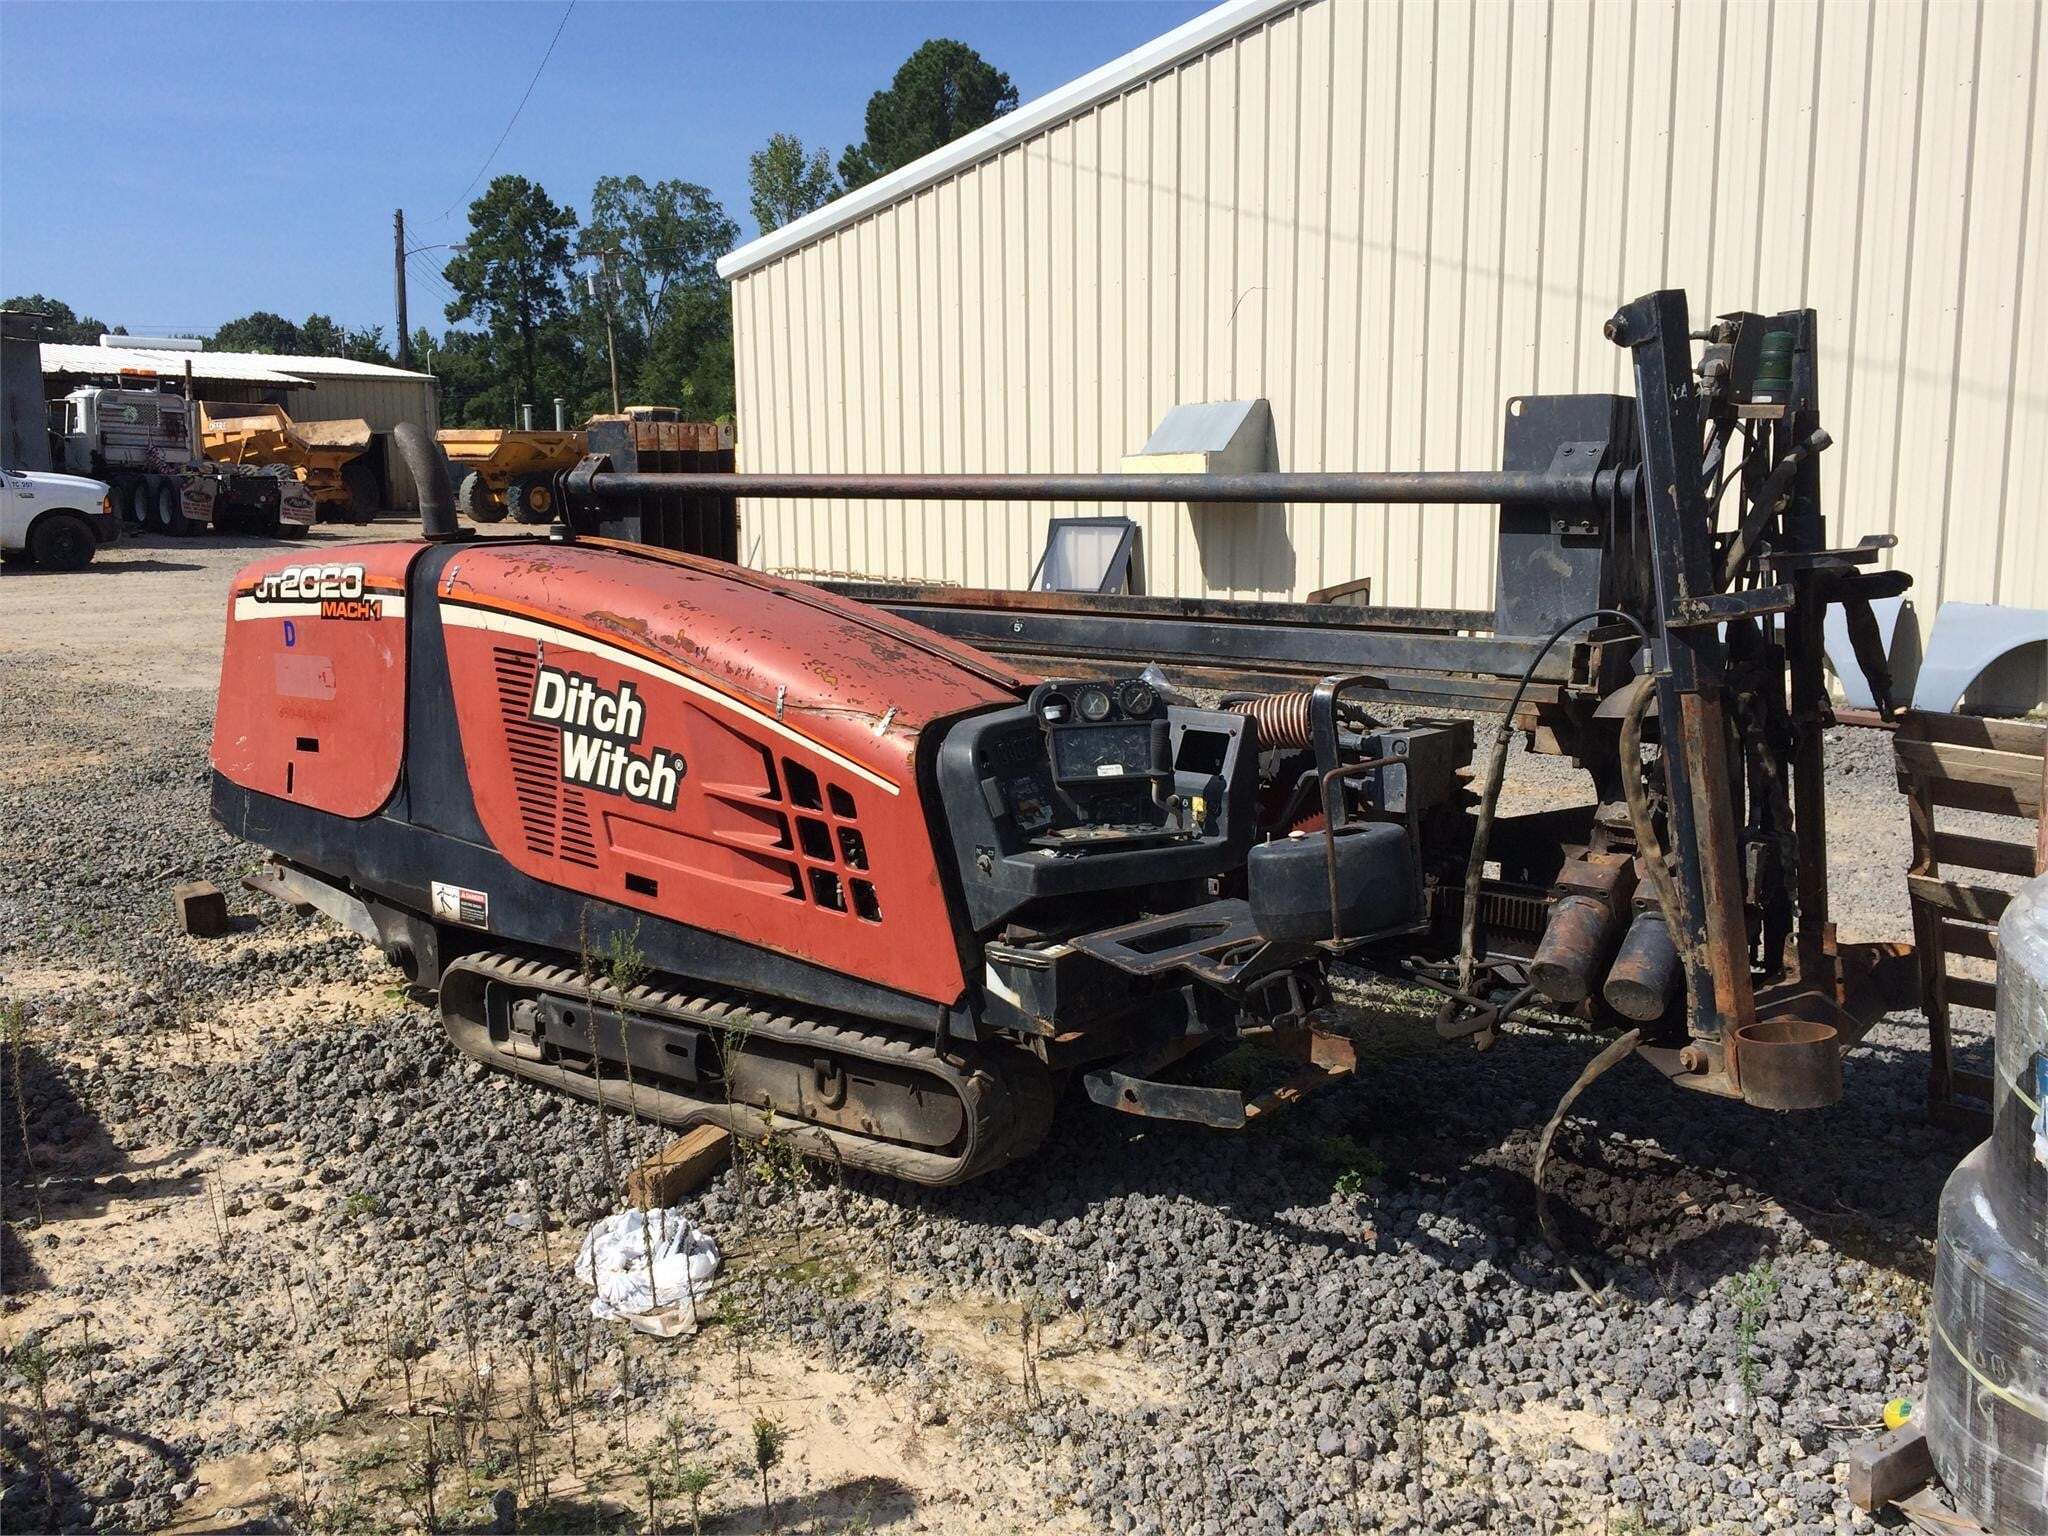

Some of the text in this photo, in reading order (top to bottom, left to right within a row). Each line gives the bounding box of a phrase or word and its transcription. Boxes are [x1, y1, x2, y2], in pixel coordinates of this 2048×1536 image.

[255, 566, 363, 599] JT2020
[322, 600, 382, 618] MACH 1
[284, 620, 295, 647] D
[532, 670, 642, 737] Ditch
